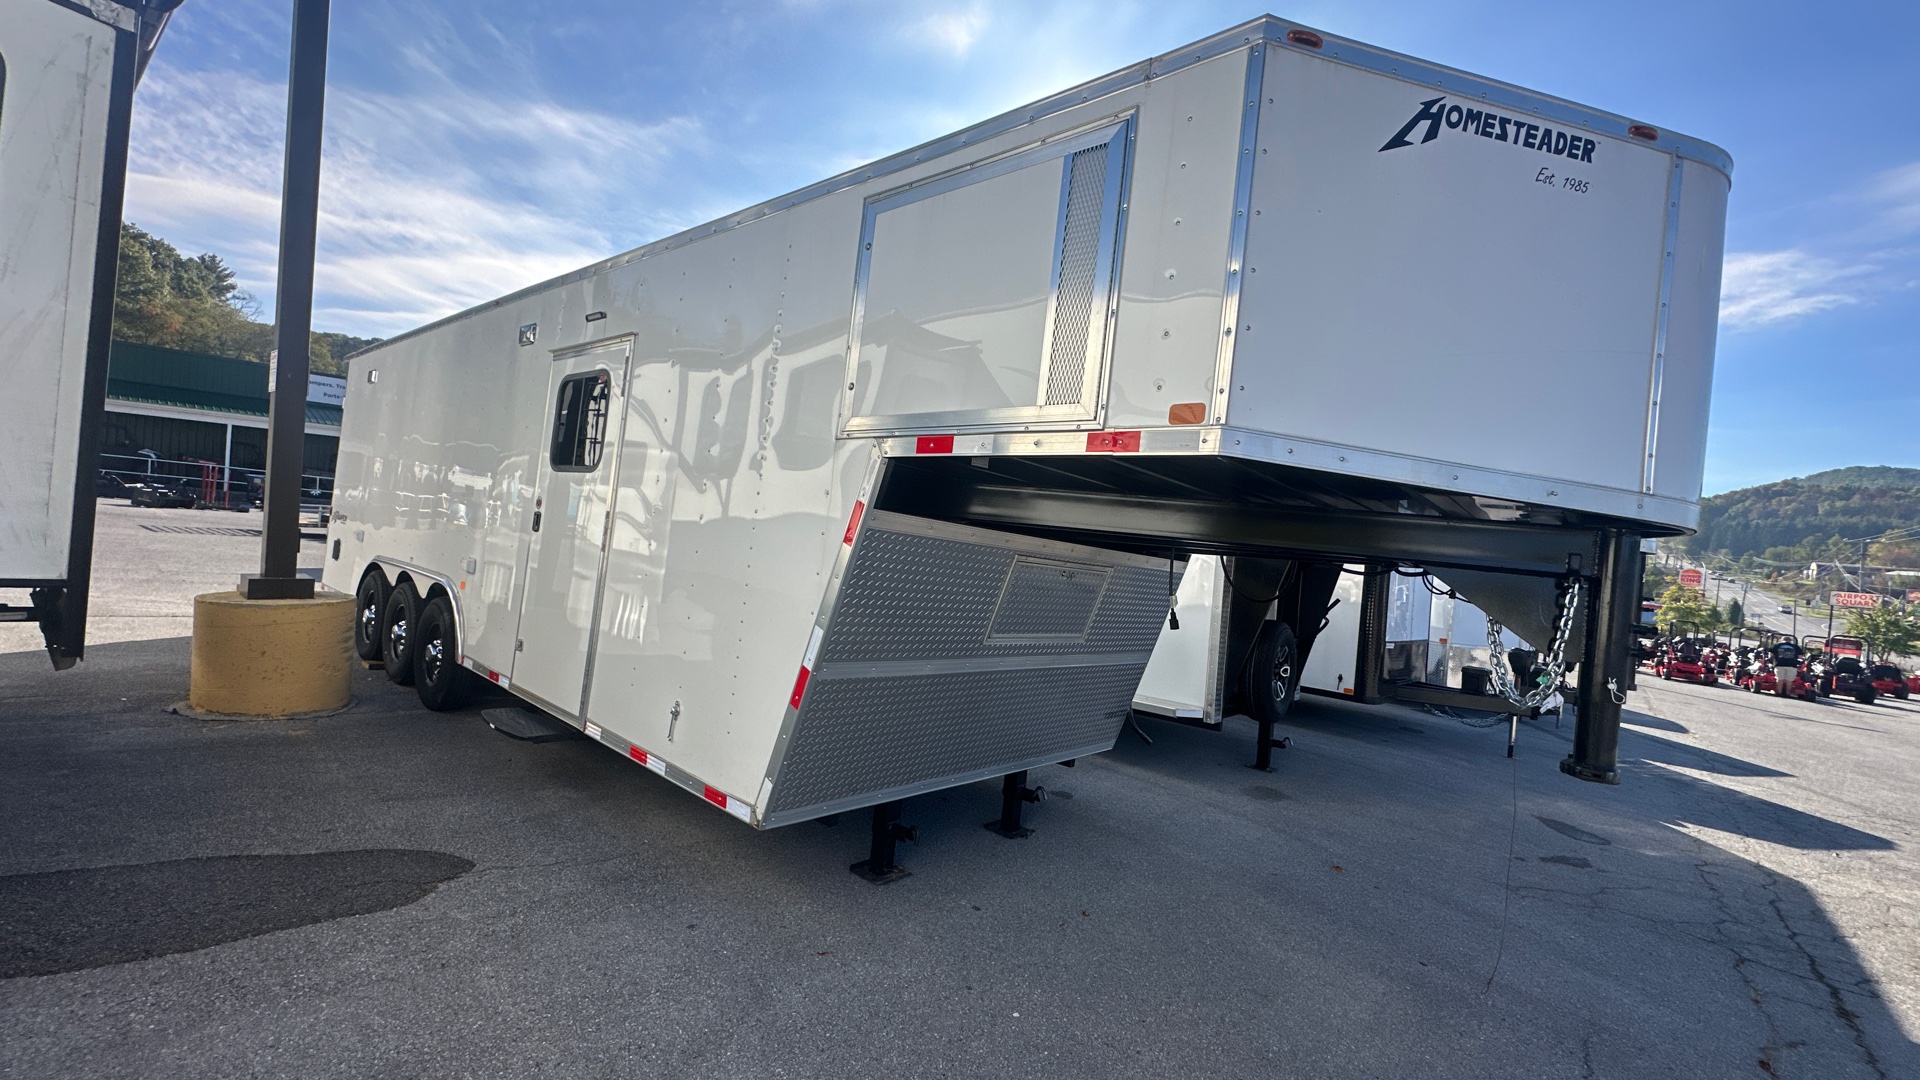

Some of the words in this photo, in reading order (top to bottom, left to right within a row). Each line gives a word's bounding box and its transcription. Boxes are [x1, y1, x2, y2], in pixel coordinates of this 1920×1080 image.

[1378, 96, 1596, 163] HOMESTEADER
[1535, 167, 1556, 187] Est.
[1563, 177, 1590, 194] 1985
[1835, 592, 1881, 602] AIRPORT
